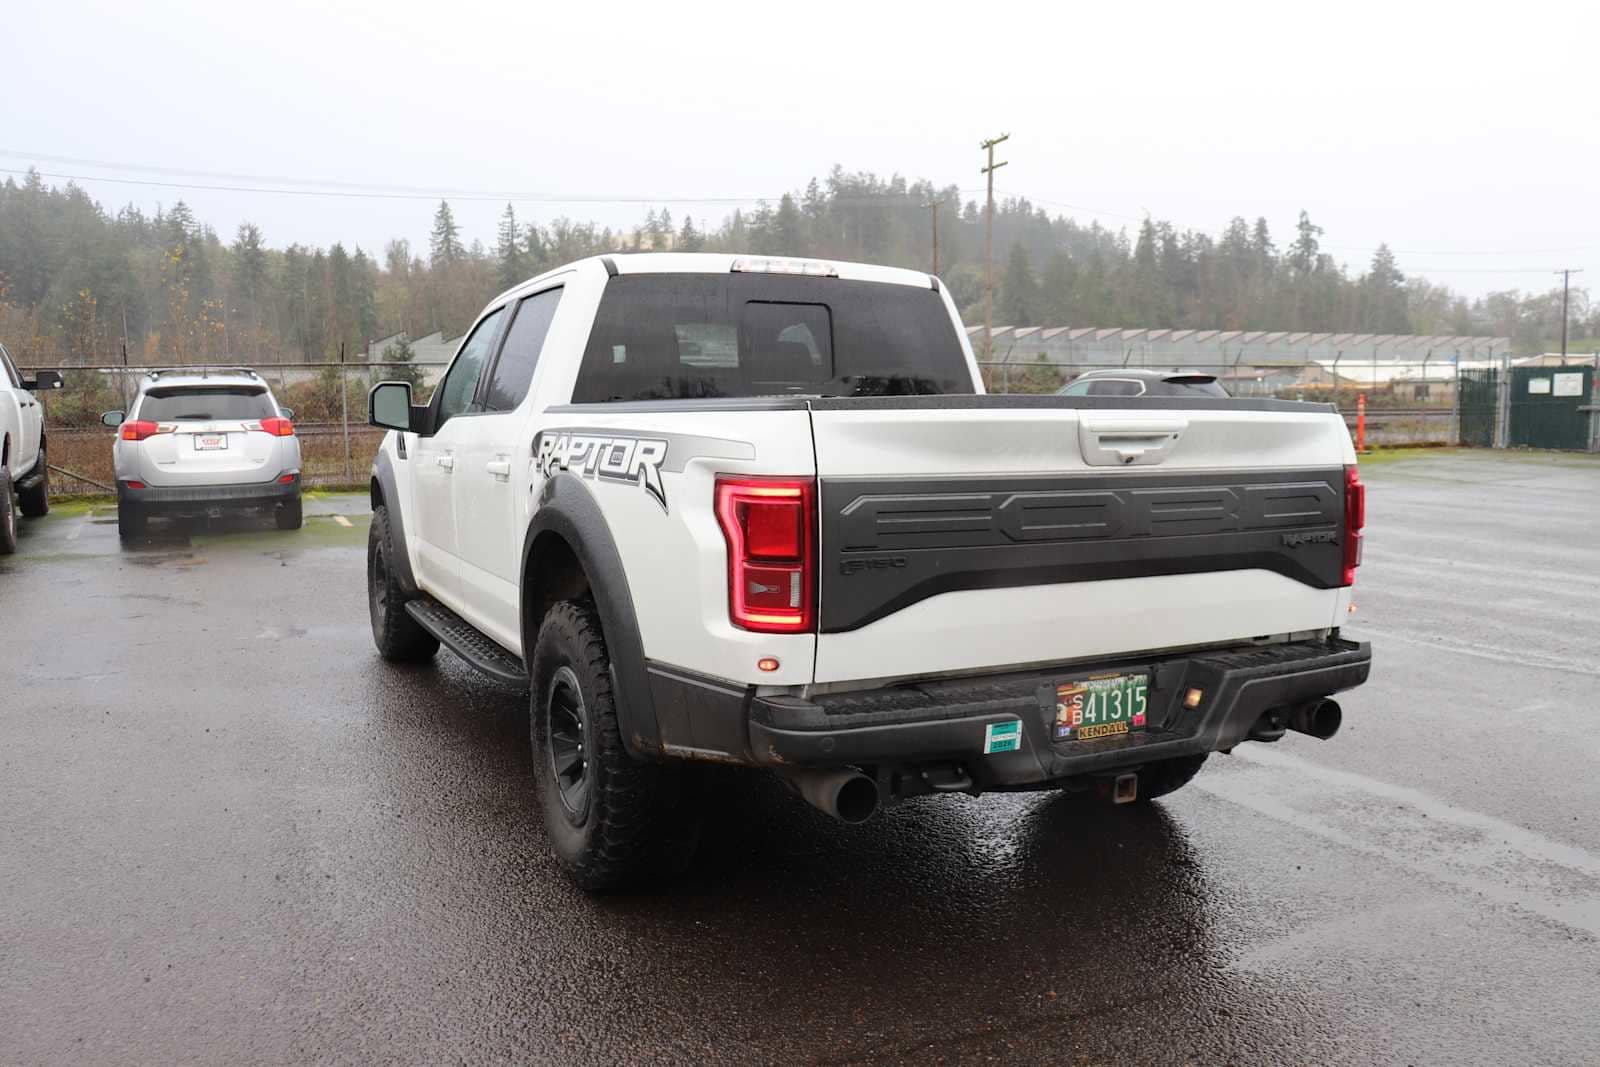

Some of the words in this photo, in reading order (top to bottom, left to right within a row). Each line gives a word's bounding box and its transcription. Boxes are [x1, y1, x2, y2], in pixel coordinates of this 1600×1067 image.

[535, 431, 668, 514] RAPTOR
[840, 482, 1337, 553] FORD
[1281, 531, 1339, 549] RAPTOR
[1085, 686, 1147, 722] 41315
[1079, 722, 1128, 738] KENDALL
